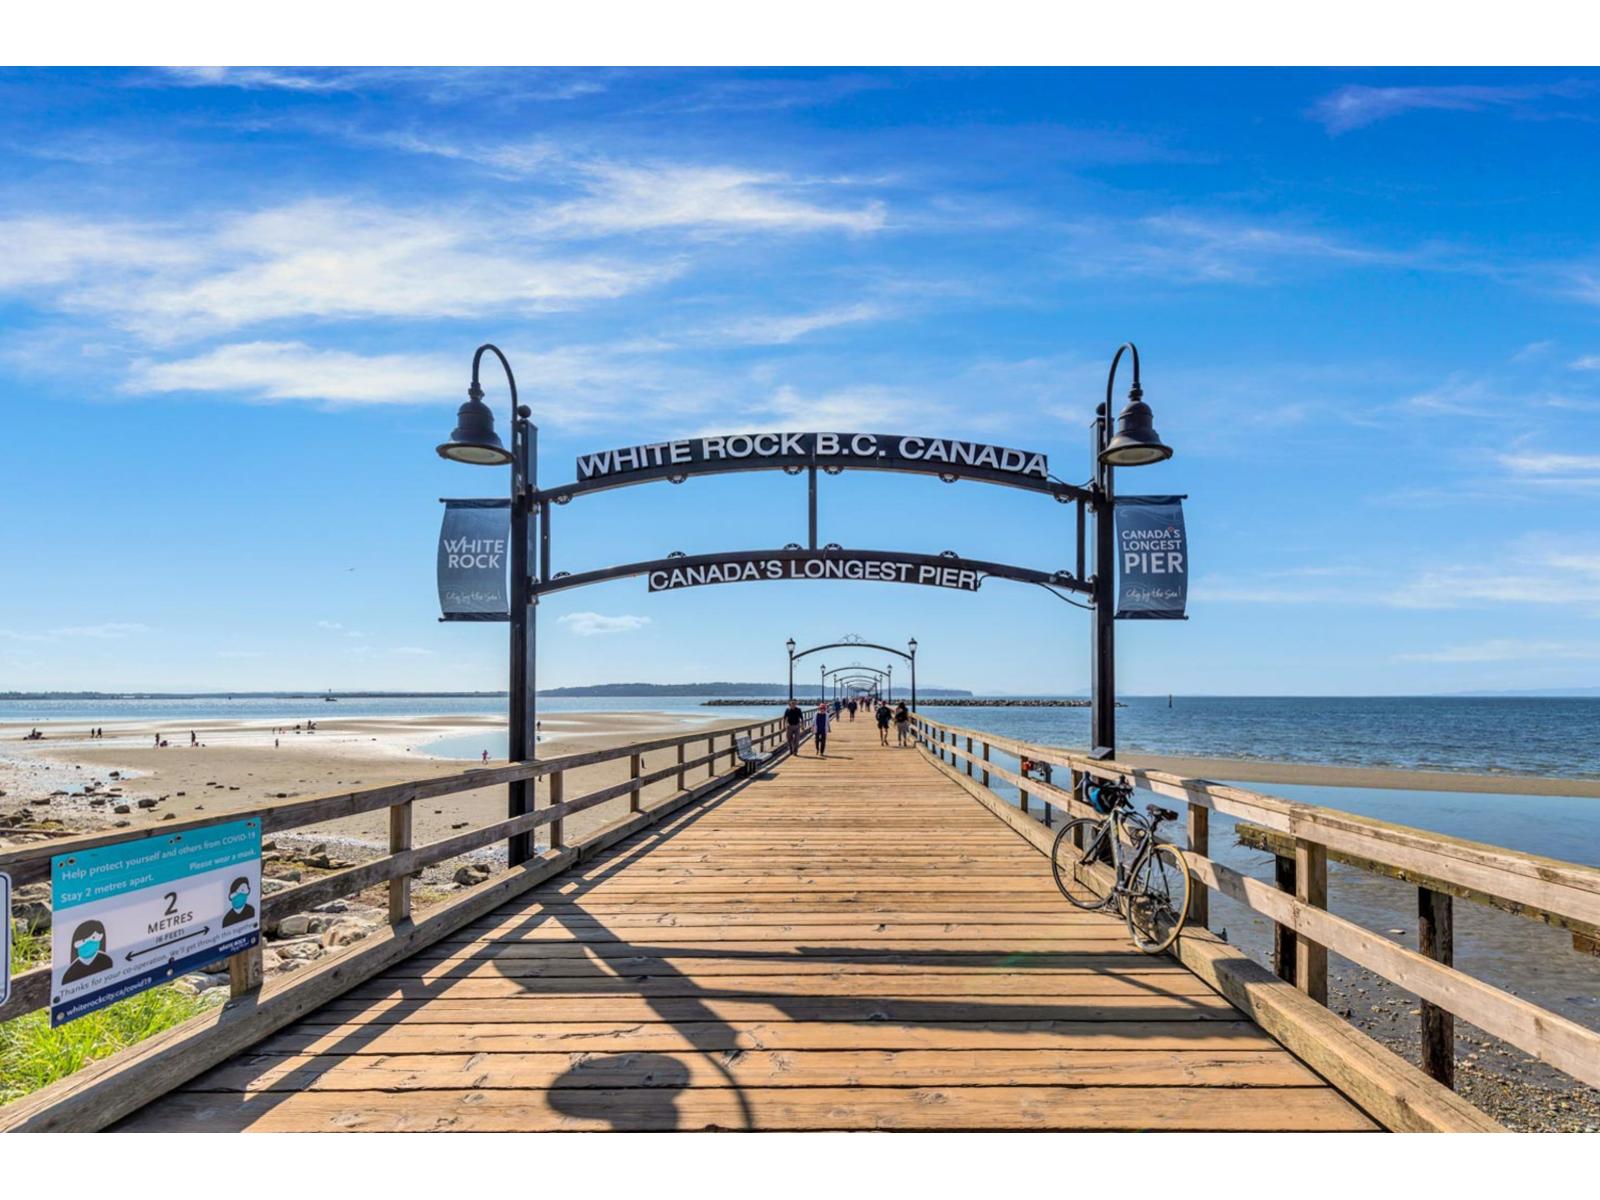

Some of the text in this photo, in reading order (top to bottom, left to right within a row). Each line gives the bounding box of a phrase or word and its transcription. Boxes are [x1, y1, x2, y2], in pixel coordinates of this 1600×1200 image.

[577, 432, 1049, 478] WHITE ROCK B.C. CANADA
[443, 536, 505, 554] WHITE
[1122, 540, 1182, 551] LONGEST
[448, 554, 500, 569] ROCK
[1124, 552, 1184, 574] PIER
[649, 559, 977, 591] CANADA'S LONGEST PIER
[62, 831, 256, 881] Help protect yourself and others from COVID-19
[189, 859, 213, 871] Please
[214, 855, 231, 864] wear
[61, 873, 154, 903] Stay 2 metres apart.
[164, 892, 178, 916] 2
[147, 911, 194, 935] METRES
[60, 983, 88, 998] Thanks
[91, 977, 103, 987] for
[104, 971, 121, 984] your
